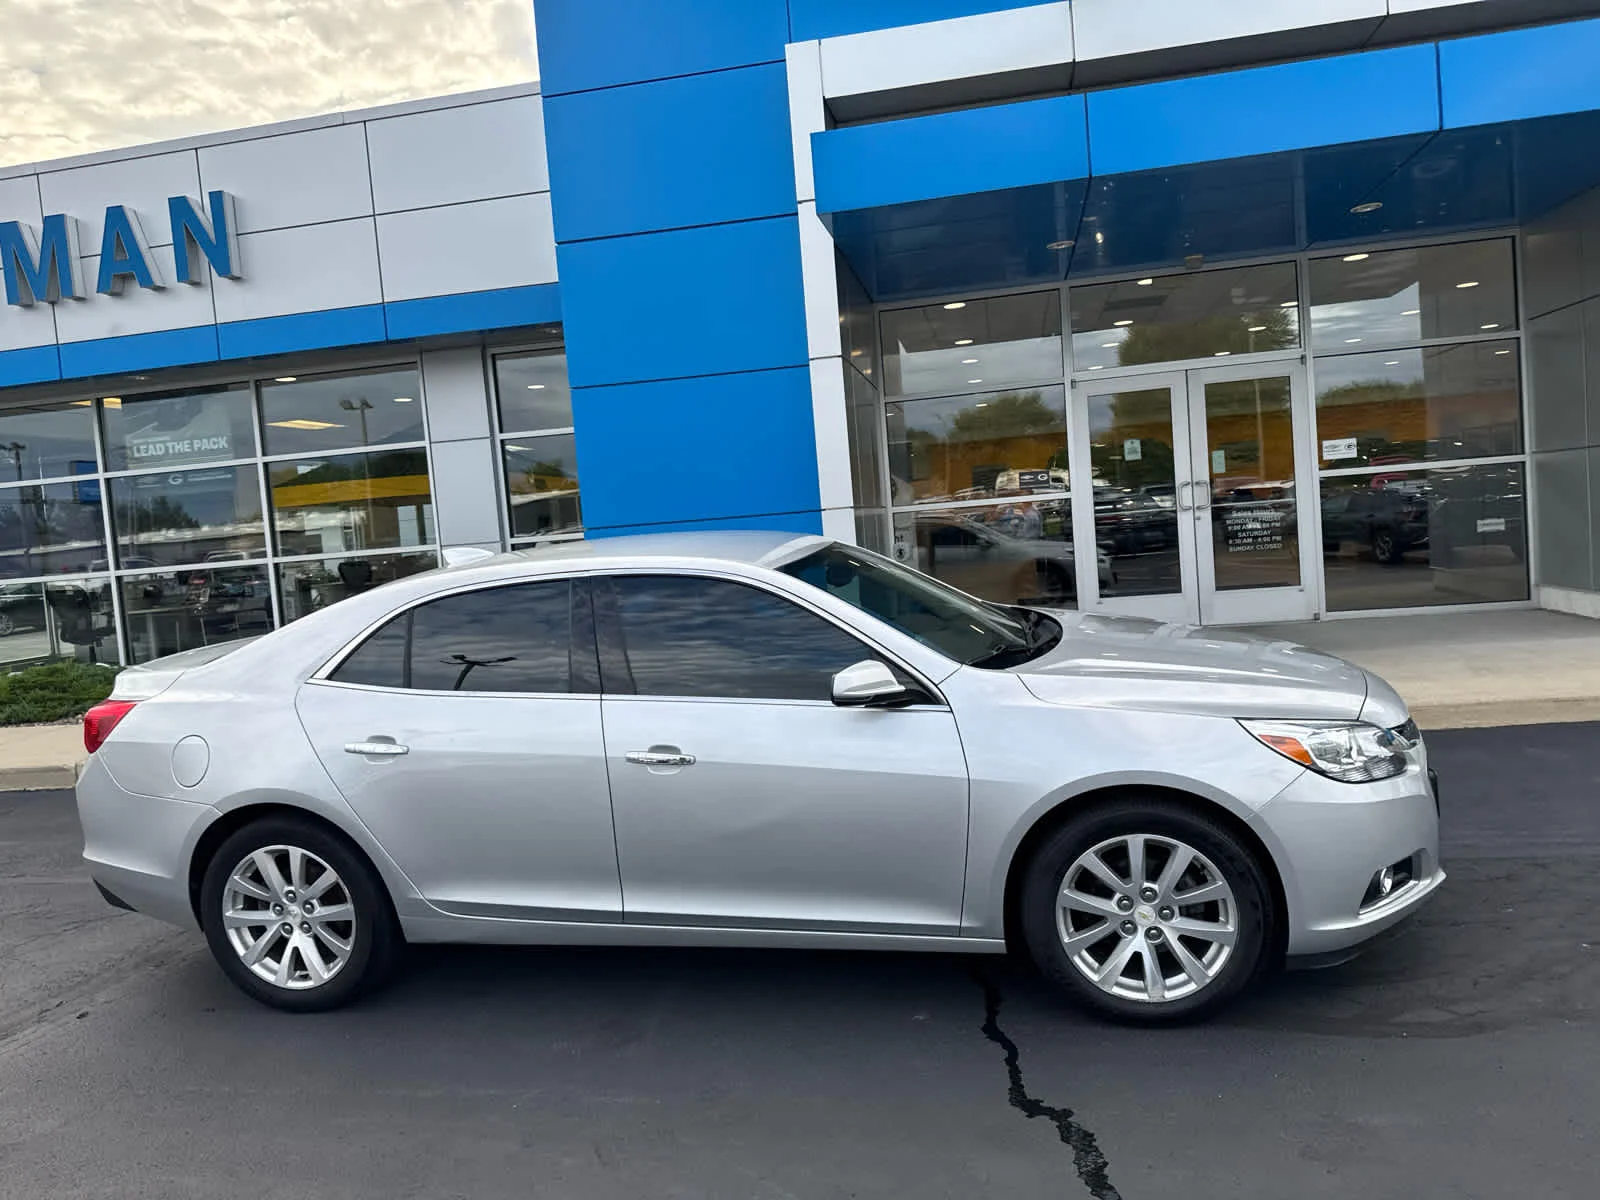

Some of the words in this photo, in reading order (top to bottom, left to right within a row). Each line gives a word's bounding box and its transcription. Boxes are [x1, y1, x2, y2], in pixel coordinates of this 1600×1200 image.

[0, 190, 240, 306] MAN
[133, 443, 165, 457] LEAD
[165, 440, 193, 454] THE
[193, 436, 228, 451] PACK
